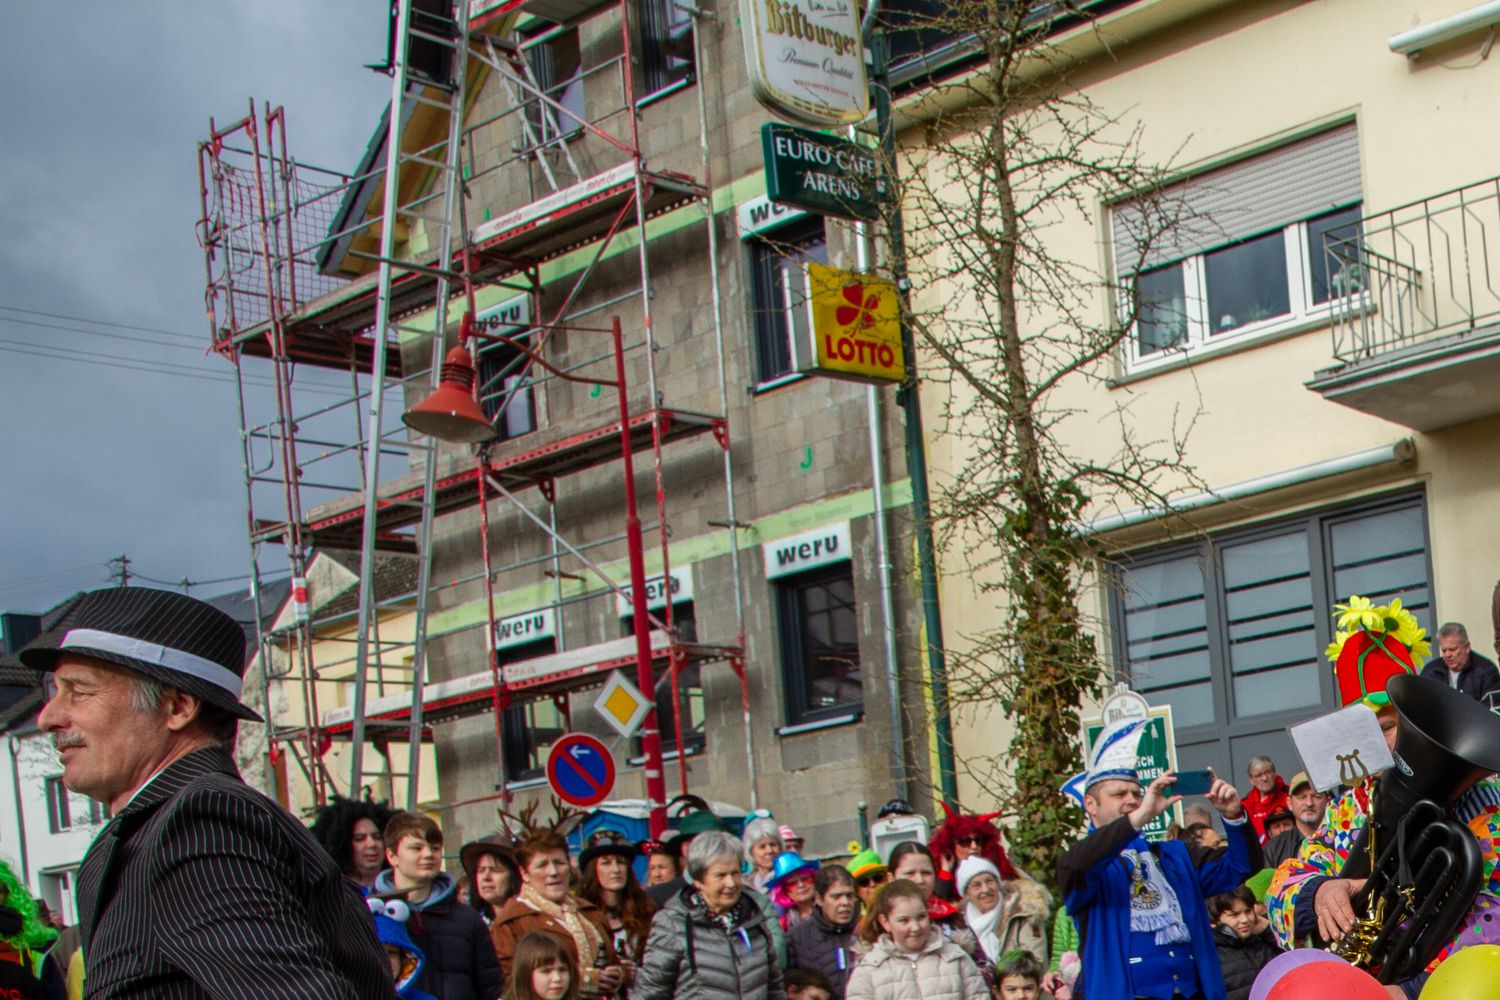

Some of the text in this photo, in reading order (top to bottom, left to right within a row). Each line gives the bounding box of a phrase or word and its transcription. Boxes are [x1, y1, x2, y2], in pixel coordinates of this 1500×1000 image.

[766, 0, 857, 57] Bitburger
[778, 47, 820, 69] Premium
[775, 136, 832, 165] EURO
[803, 170, 860, 201] ARENS
[825, 334, 895, 369] LOTTO
[776, 535, 838, 566] weru
[495, 613, 545, 640] weru
